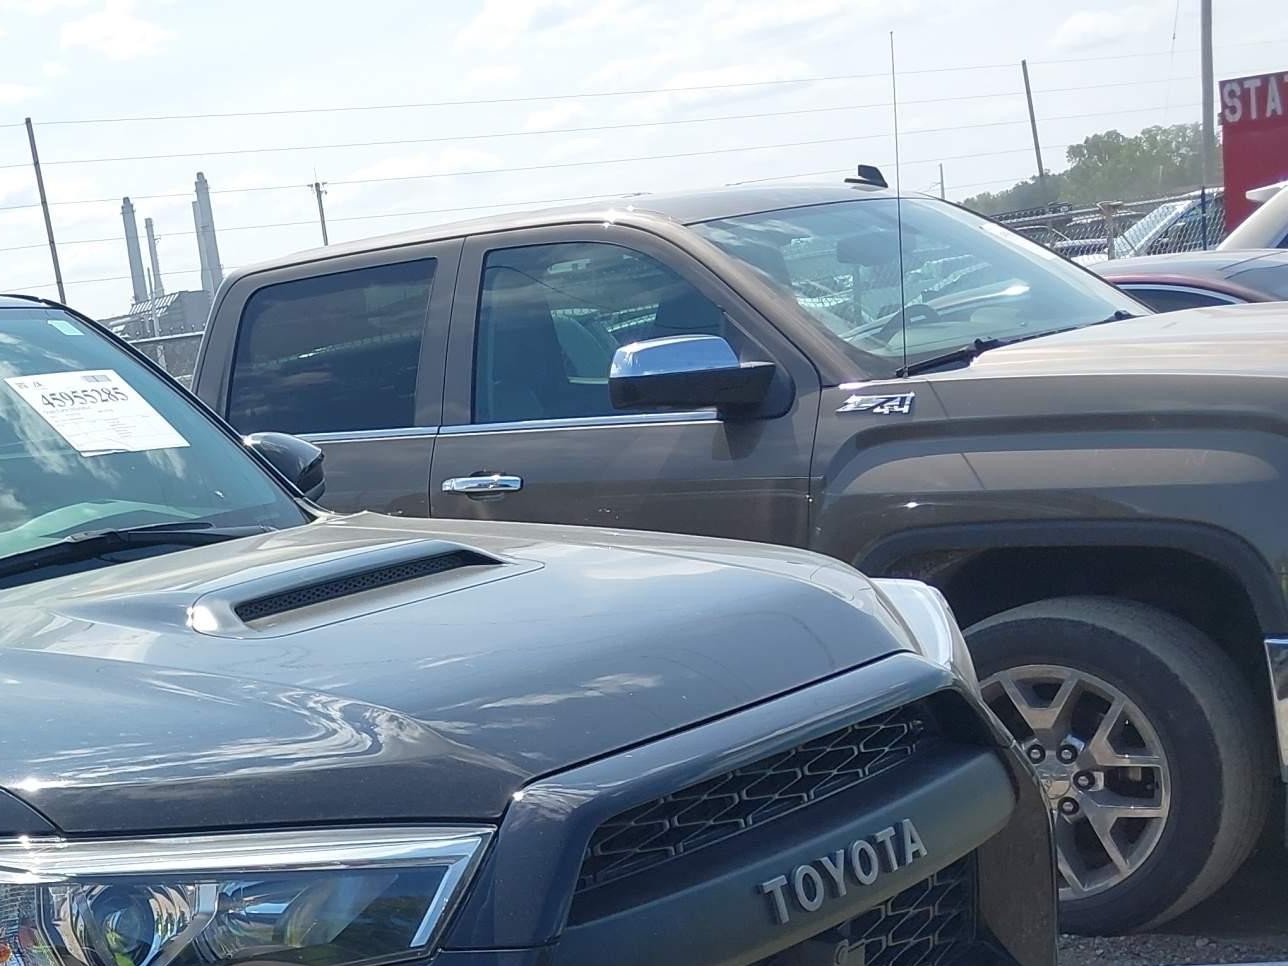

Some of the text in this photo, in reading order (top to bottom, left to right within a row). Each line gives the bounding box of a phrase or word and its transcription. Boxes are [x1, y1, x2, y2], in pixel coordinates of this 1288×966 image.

[1223, 73, 1288, 122] STA
[41, 387, 129, 408] 45955285
[760, 818, 928, 925] TOYOTA
